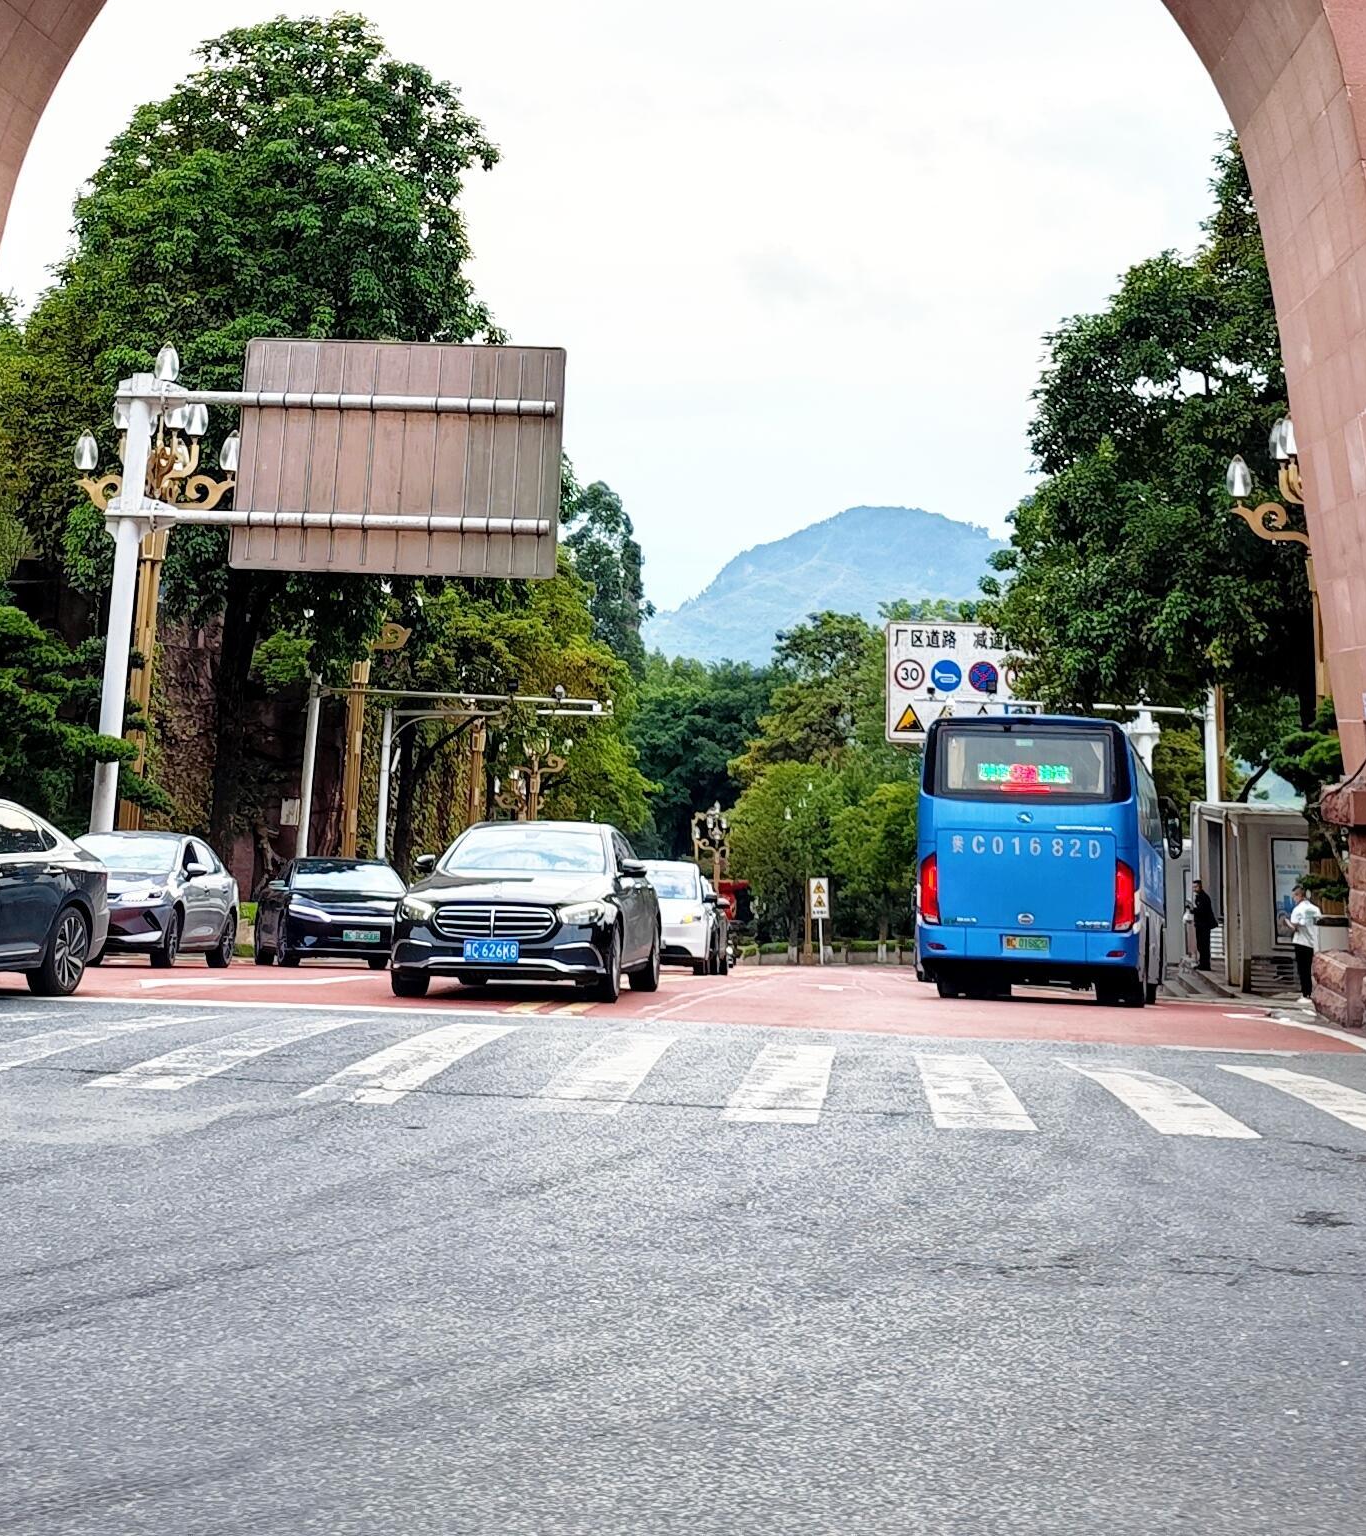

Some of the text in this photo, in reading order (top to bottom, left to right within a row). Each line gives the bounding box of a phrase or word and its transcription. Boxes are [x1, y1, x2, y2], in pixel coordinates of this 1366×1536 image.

[894, 629, 957, 650] 厂区道路
[901, 668, 919, 681] 30
